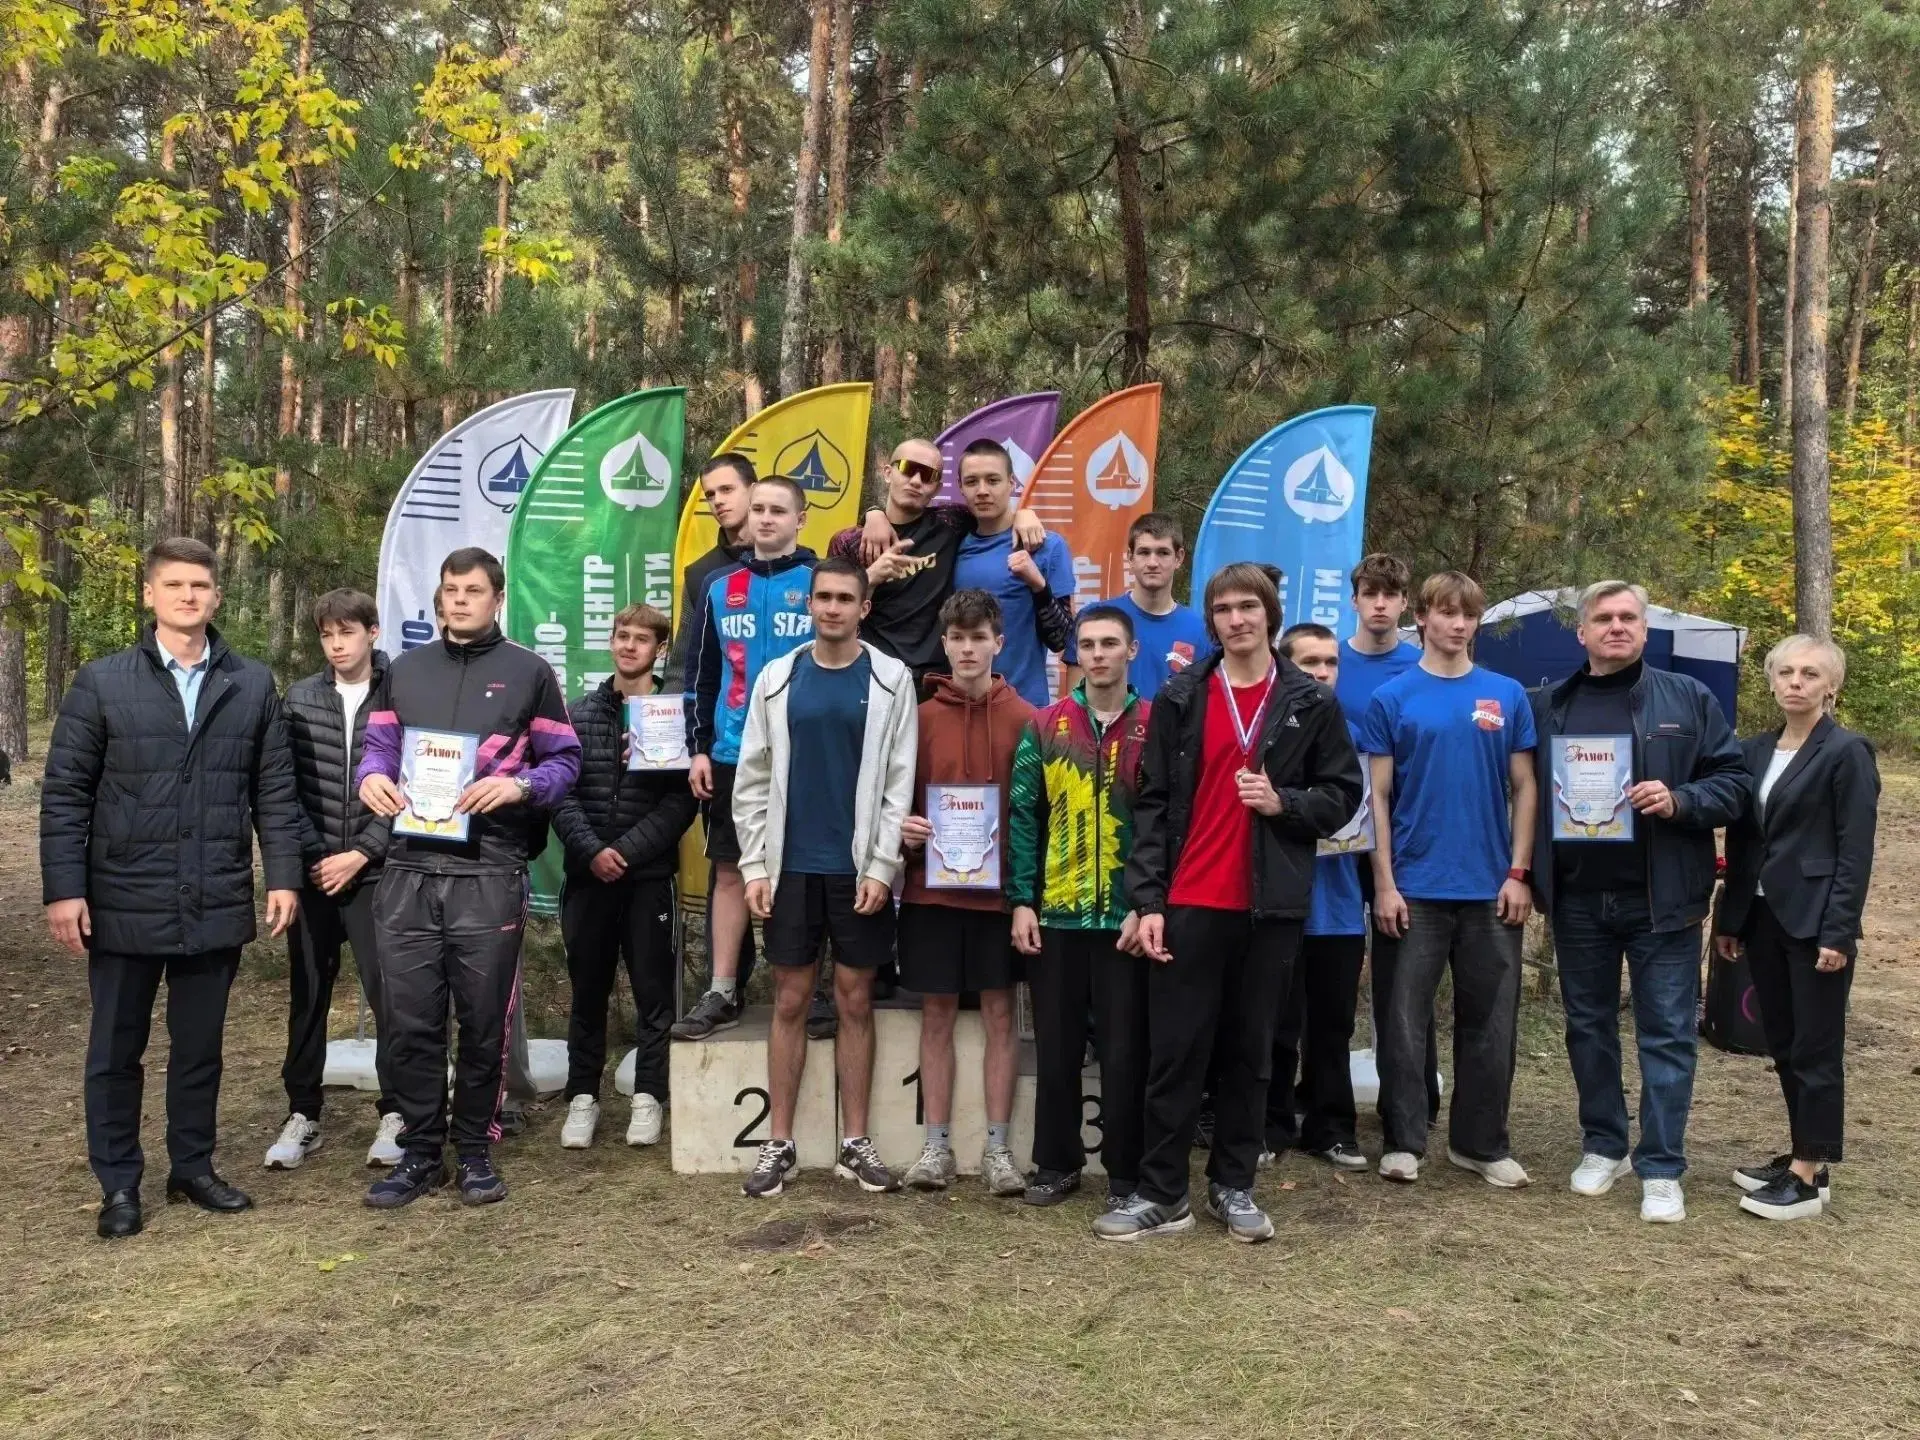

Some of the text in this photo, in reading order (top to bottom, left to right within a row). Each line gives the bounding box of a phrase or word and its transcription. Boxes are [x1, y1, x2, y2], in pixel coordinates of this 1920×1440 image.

[584, 554, 615, 650] ЦЕНТР
[720, 613, 756, 639] RUS
[1310, 568, 1343, 634] СТИ
[1564, 744, 1616, 762] ГРАМОТА
[938, 793, 985, 811] ГРАМОТА
[733, 1086, 774, 1148] 2
[902, 1066, 924, 1125] 1
